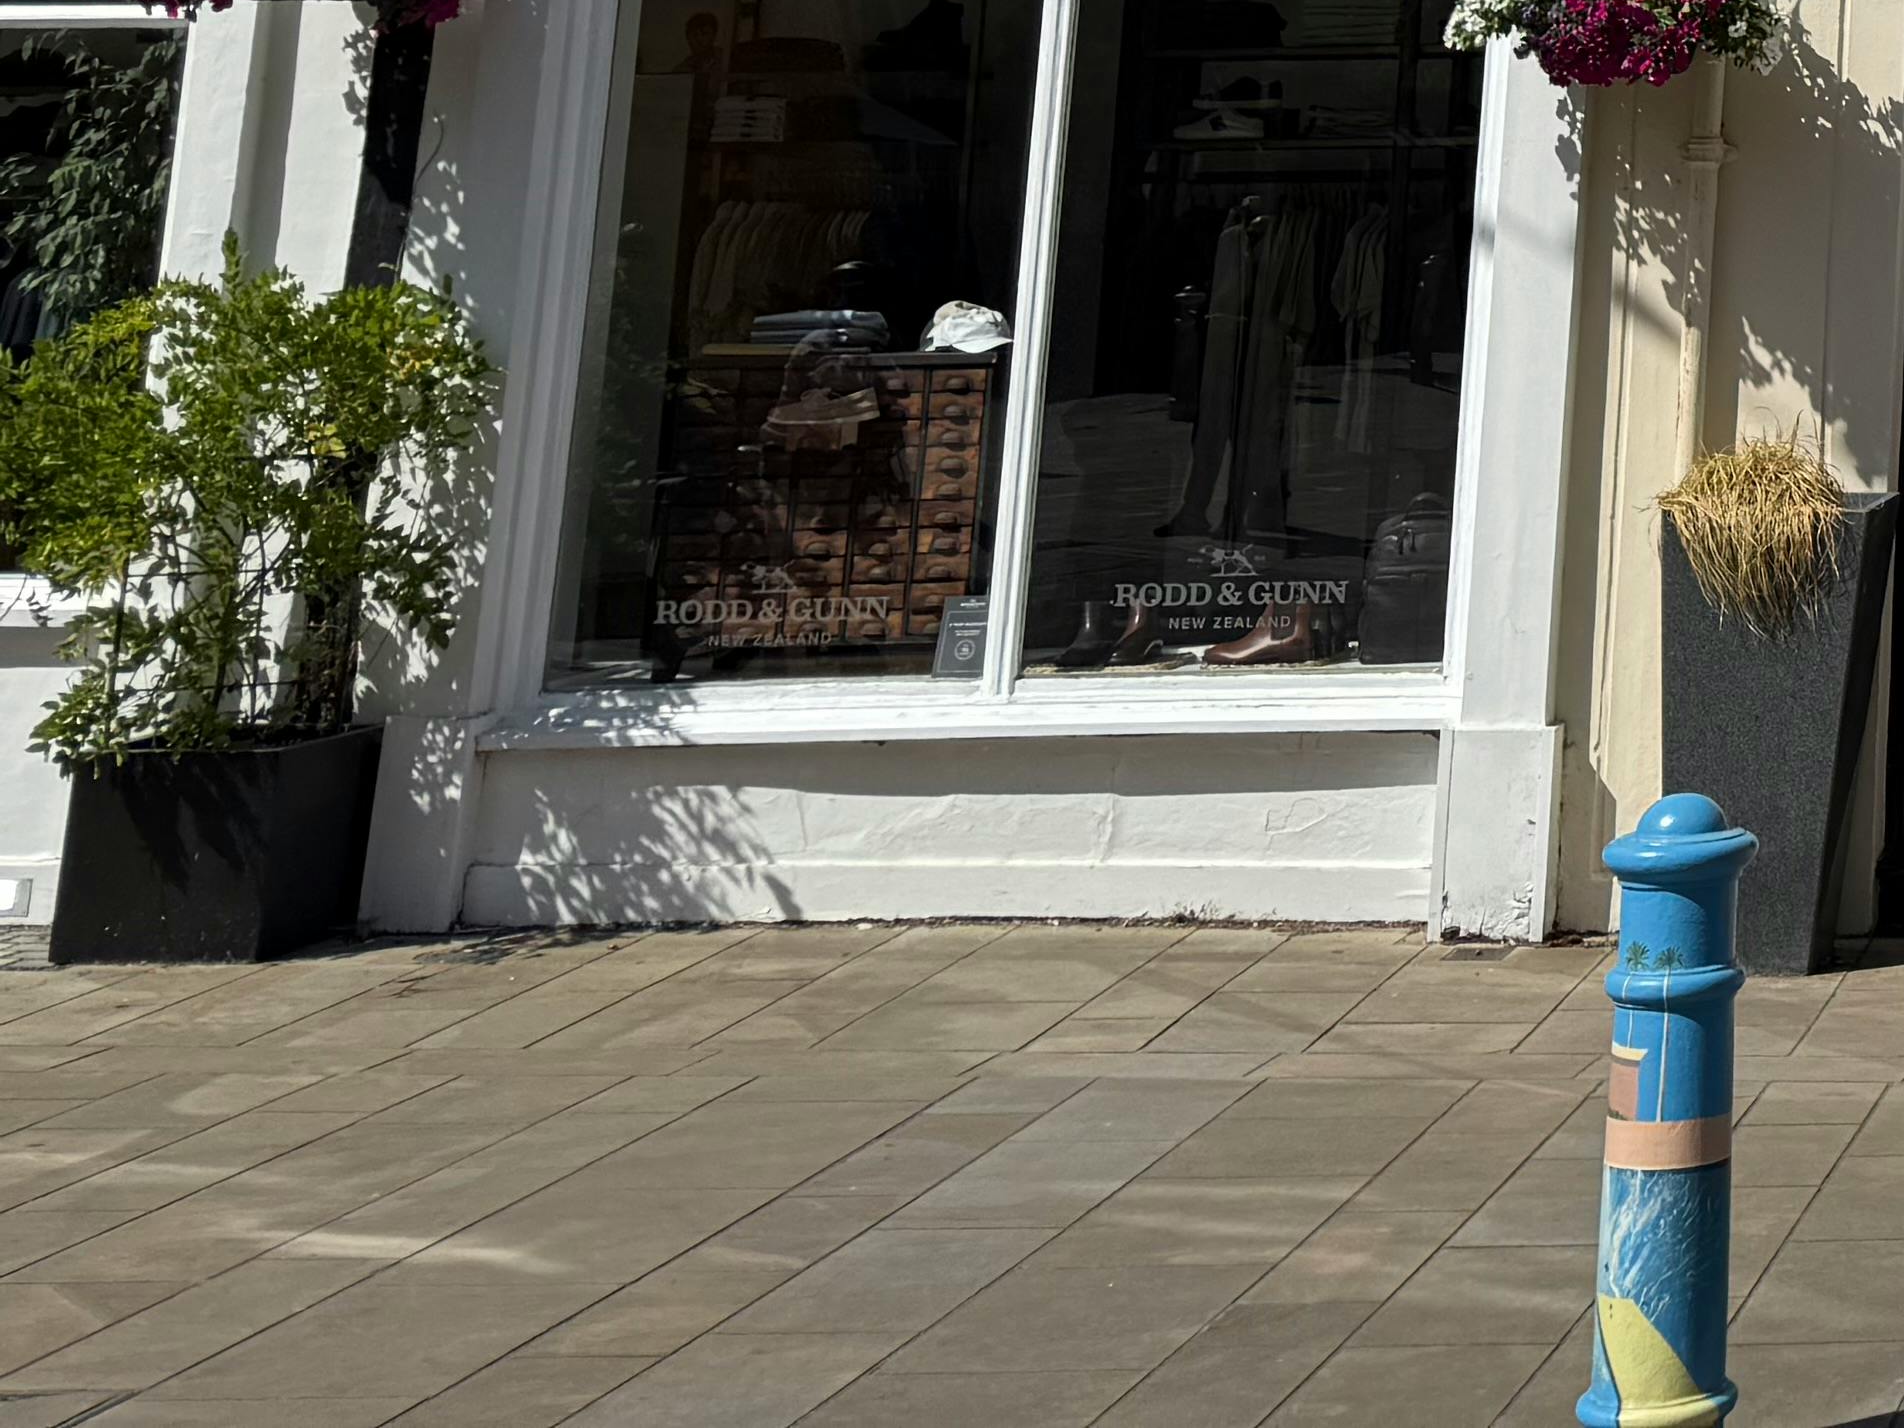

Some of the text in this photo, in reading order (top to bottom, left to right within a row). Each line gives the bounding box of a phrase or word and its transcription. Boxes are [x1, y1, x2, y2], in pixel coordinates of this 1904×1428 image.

[1113, 580, 1349, 607] RODD & GUNN
[653, 596, 890, 624] RODD & GUNN
[1168, 615, 1291, 630] NEW ZEALAND
[708, 631, 833, 647] NEW ZEALAND
